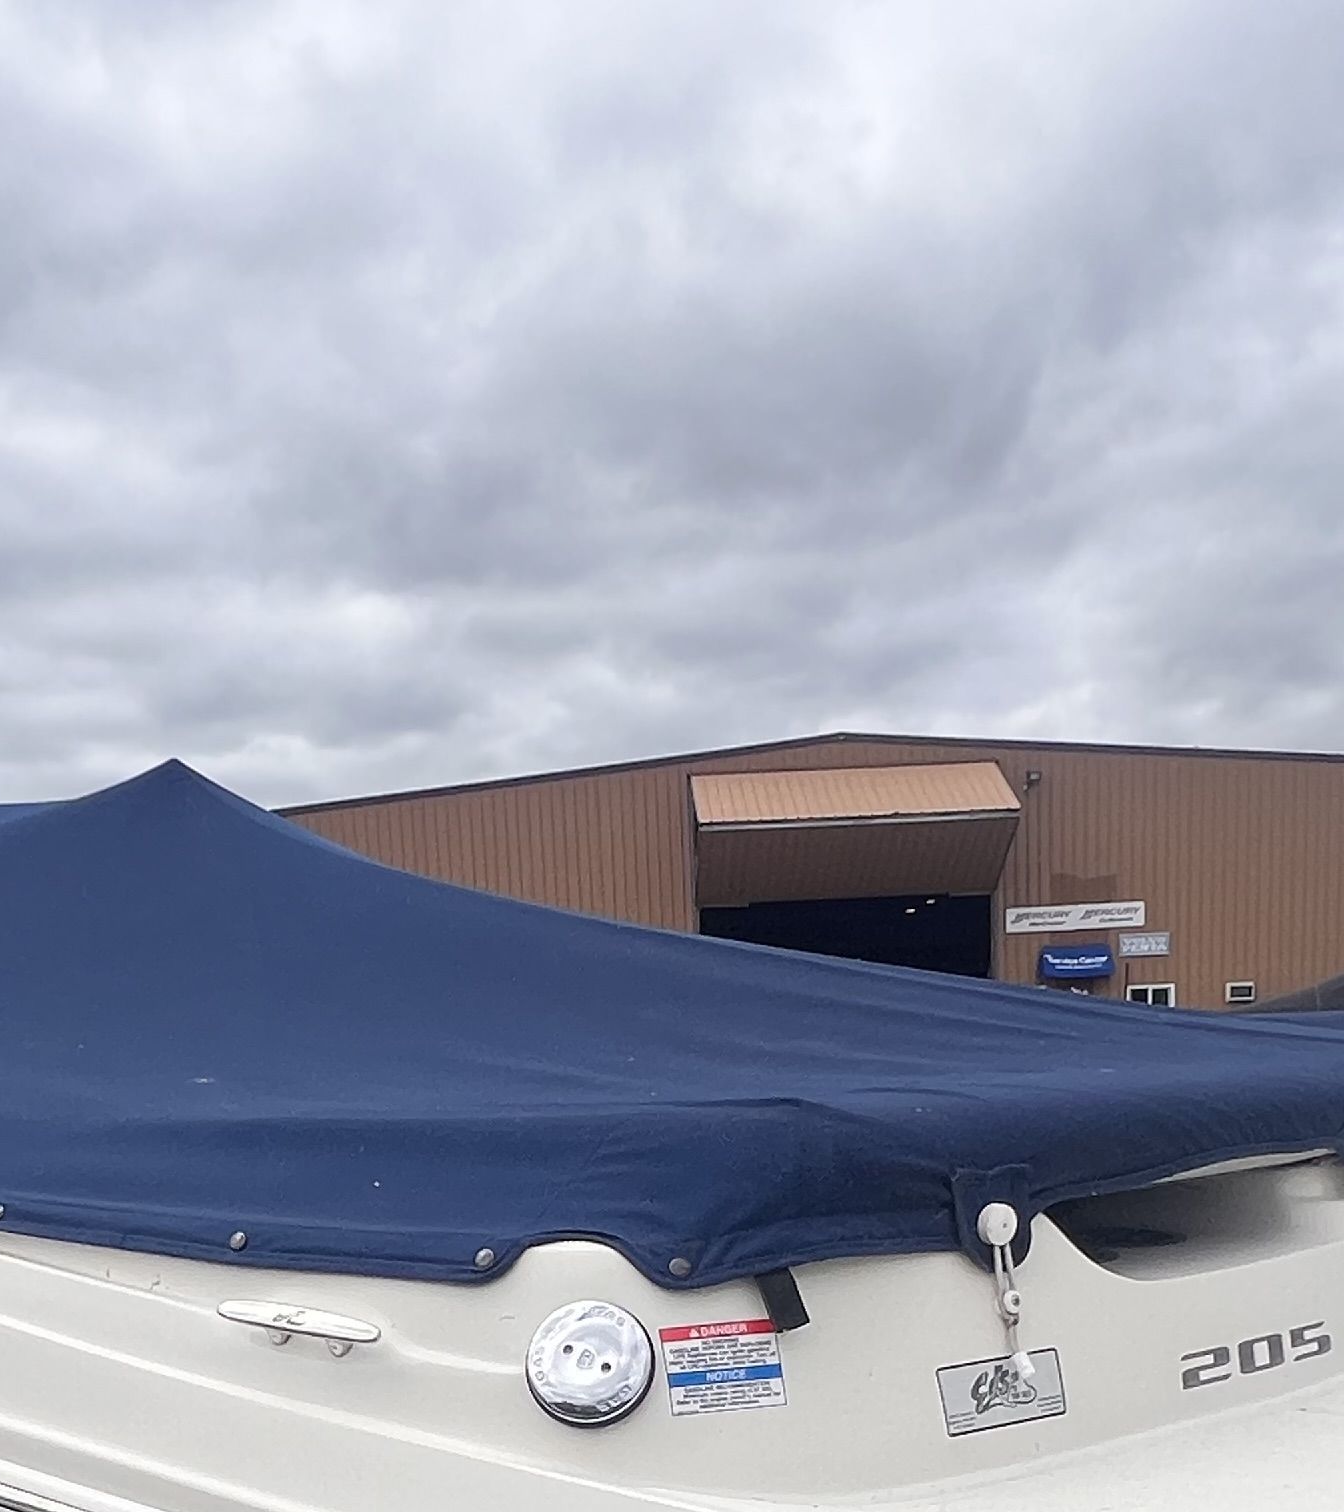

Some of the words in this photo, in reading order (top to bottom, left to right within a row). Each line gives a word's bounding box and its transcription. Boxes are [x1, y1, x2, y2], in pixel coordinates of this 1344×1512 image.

[1011, 910, 1072, 924] MERCURY
[1080, 906, 1141, 920] MERCURY
[700, 1323, 748, 1337] DANGER
[1180, 1319, 1332, 1390] 205
[705, 1369, 747, 1382] NOTICE
